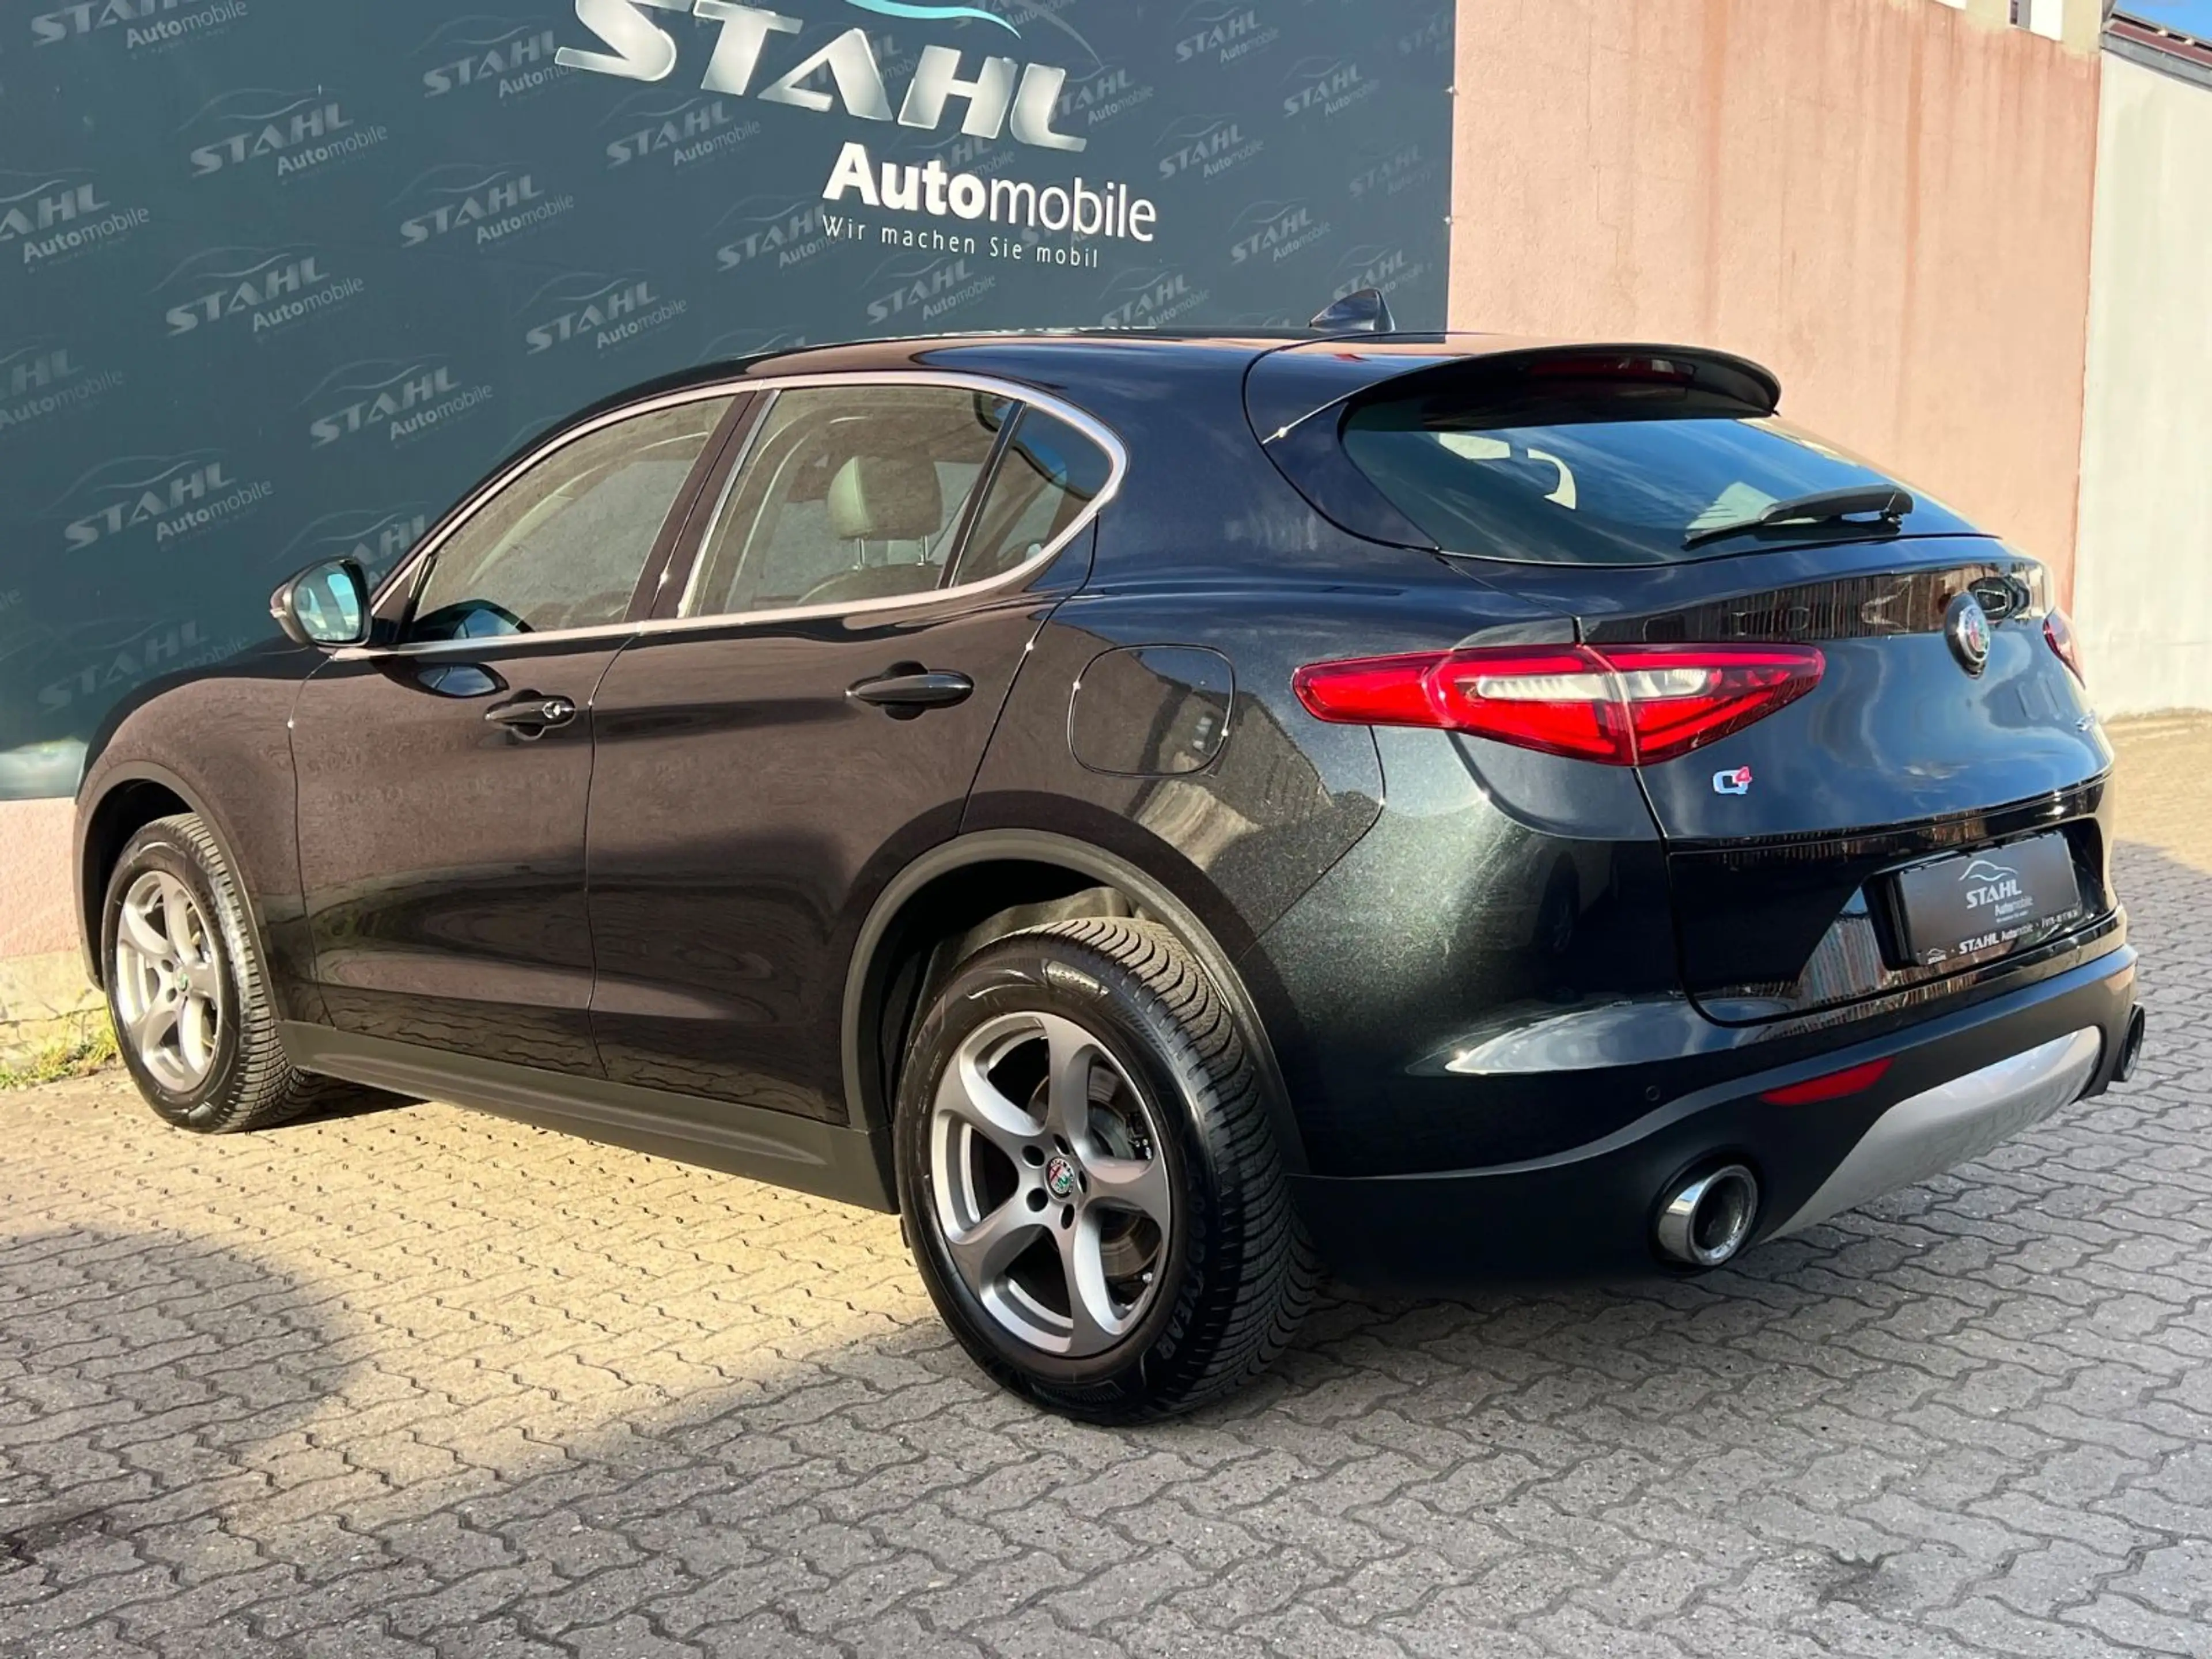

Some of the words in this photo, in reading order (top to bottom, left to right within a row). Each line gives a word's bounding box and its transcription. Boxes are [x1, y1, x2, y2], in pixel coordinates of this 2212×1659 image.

[30, 0, 199, 48] STA
[126, 0, 249, 50] Automobile
[1175, 10, 1262, 63] STAHL
[422, 30, 556, 99] STAHL
[555, 0, 1087, 152] STAHL
[1054, 67, 1135, 120] TAHL
[1283, 62, 1363, 119] STAHL
[190, 102, 354, 177] STAHL
[277, 123, 388, 176] Automobile
[606, 100, 733, 171] STAHL
[673, 119, 762, 168] Automobile
[1158, 123, 1245, 181] STAHL
[399, 173, 545, 248] STAHL
[476, 191, 575, 245] Automobile
[822, 142, 1157, 243] Automobile
[23, 207, 150, 264] Automobile
[823, 214, 866, 240] Wir
[881, 226, 975, 255] machen
[989, 236, 1023, 260] Sie
[1036, 245, 1099, 269] mobil
[1230, 208, 1314, 266] STAHL
[166, 256, 331, 338] STAHL
[252, 275, 365, 333] Automobile
[525, 281, 660, 355] STAHL
[867, 258, 974, 326] STAHL
[923, 274, 996, 321] Automobile
[596, 297, 687, 350] Automobile
[310, 366, 461, 450] STAHL
[389, 382, 494, 442] Automobile
[64, 462, 236, 554] STAHL
[156, 479, 274, 543] Automobile
[37, 620, 211, 717] STAHL
[1966, 879, 2022, 909] STAHL
[1959, 932, 1999, 955] STAHL
